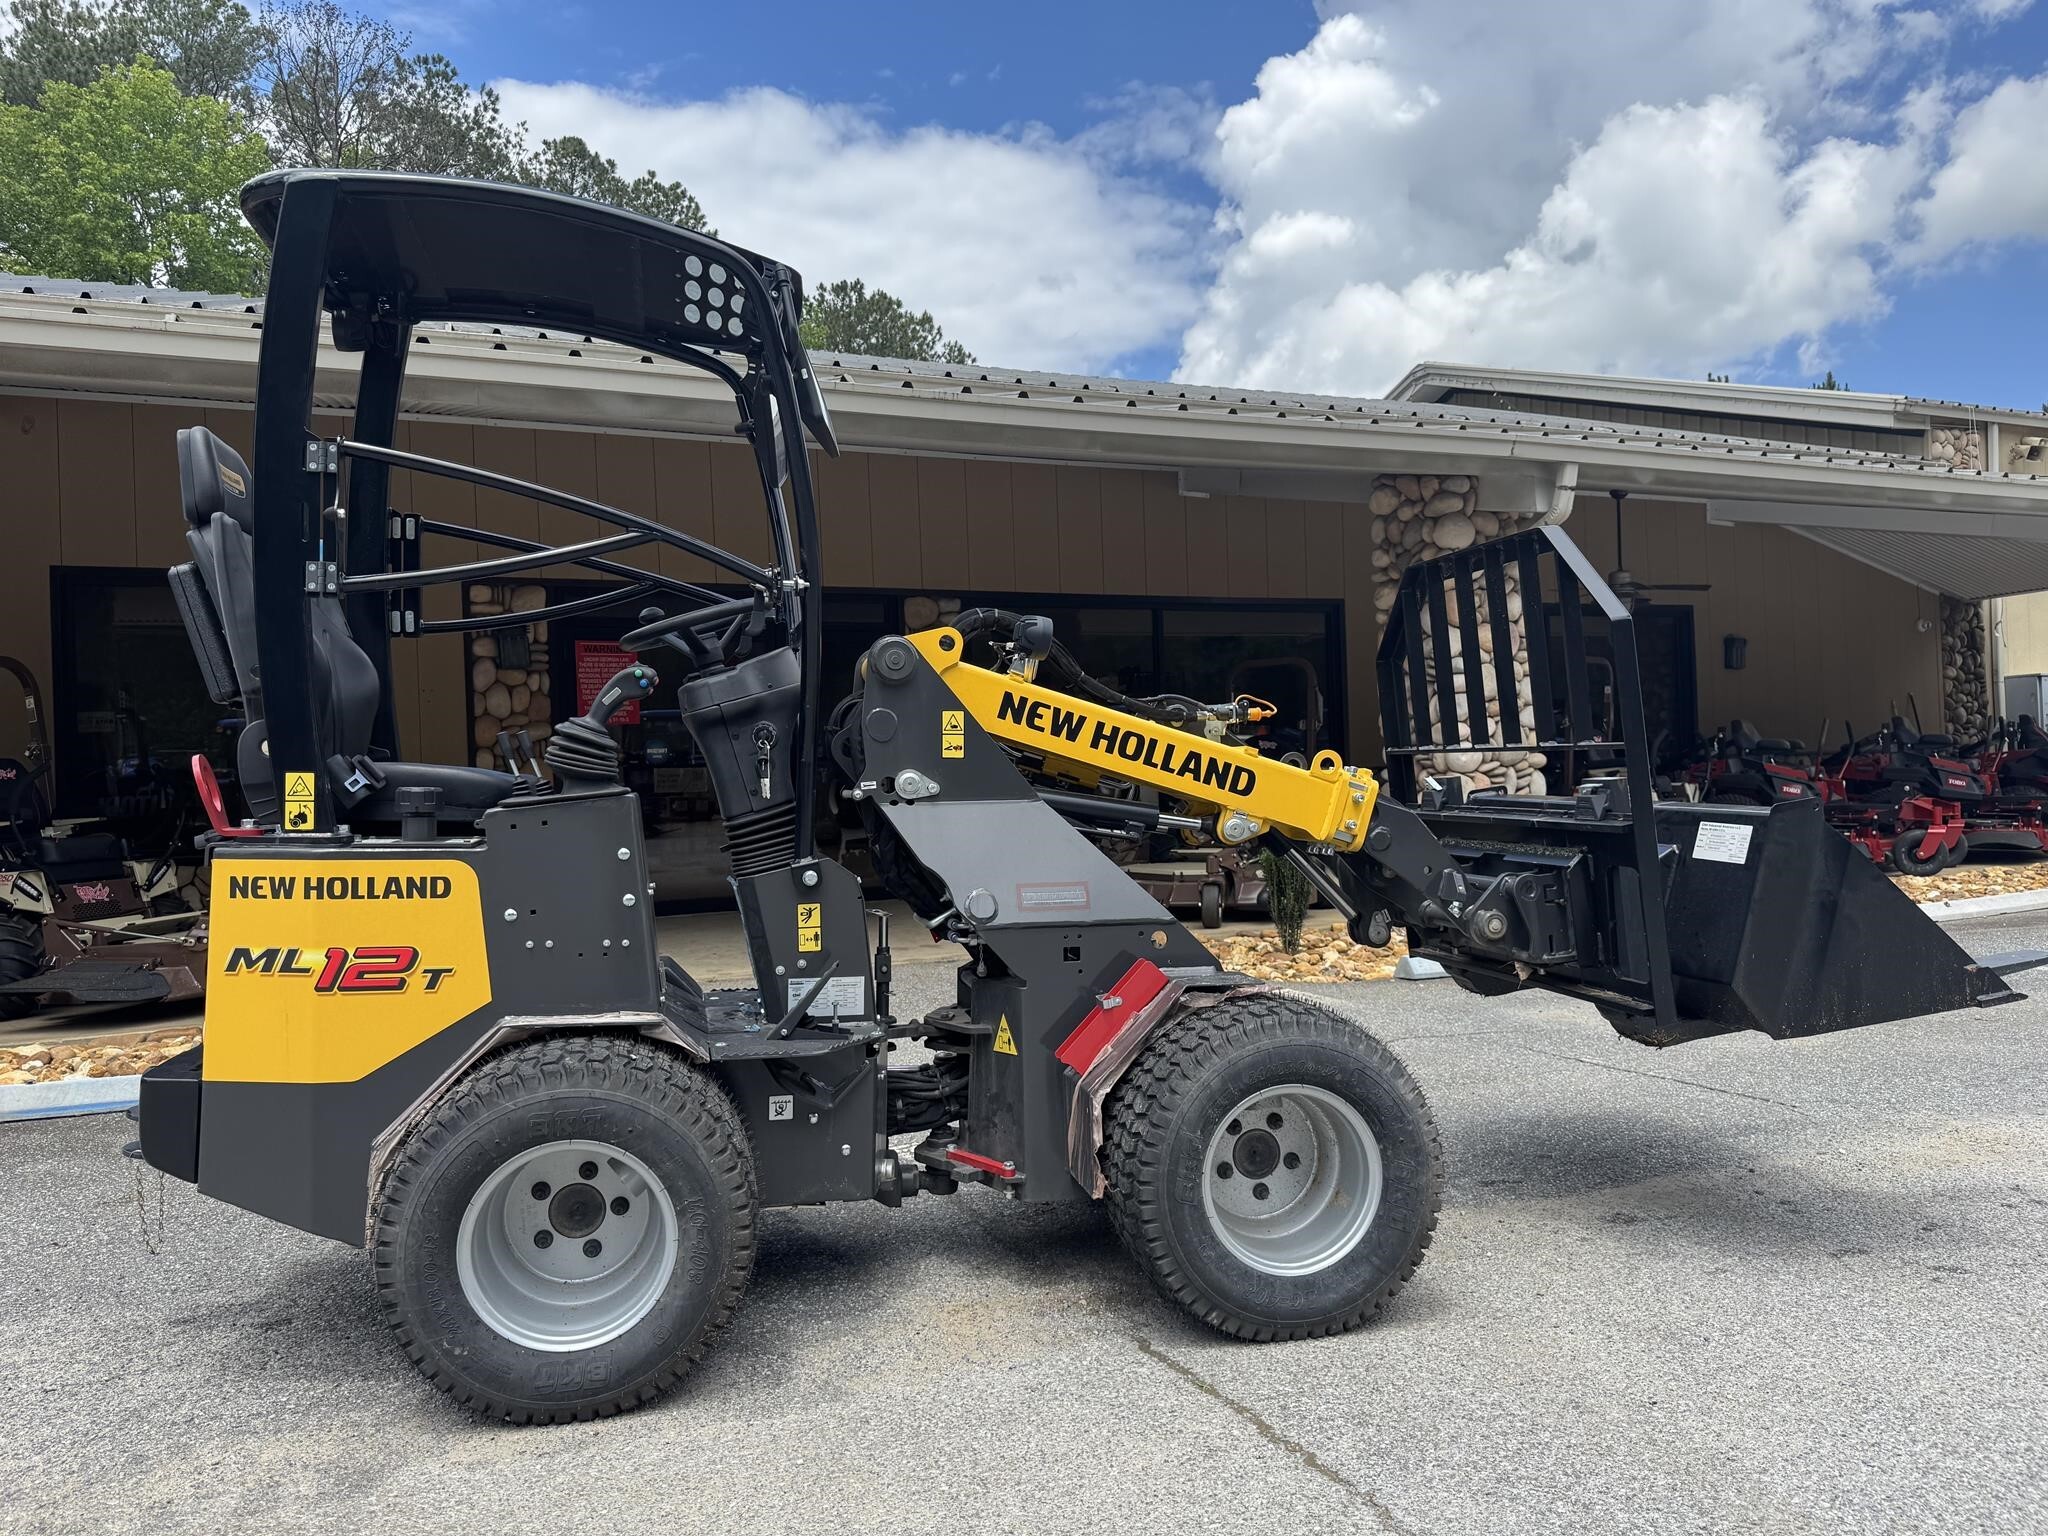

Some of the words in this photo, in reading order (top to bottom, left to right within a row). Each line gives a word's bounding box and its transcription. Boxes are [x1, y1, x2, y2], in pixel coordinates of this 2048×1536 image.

[998, 692, 1087, 742] NEW
[1090, 721, 1255, 796] HOLLAND
[1781, 785, 1801, 793] TORO
[1947, 778, 1966, 786] TORO
[230, 876, 295, 899] NEW
[303, 876, 451, 899] HOLLAND
